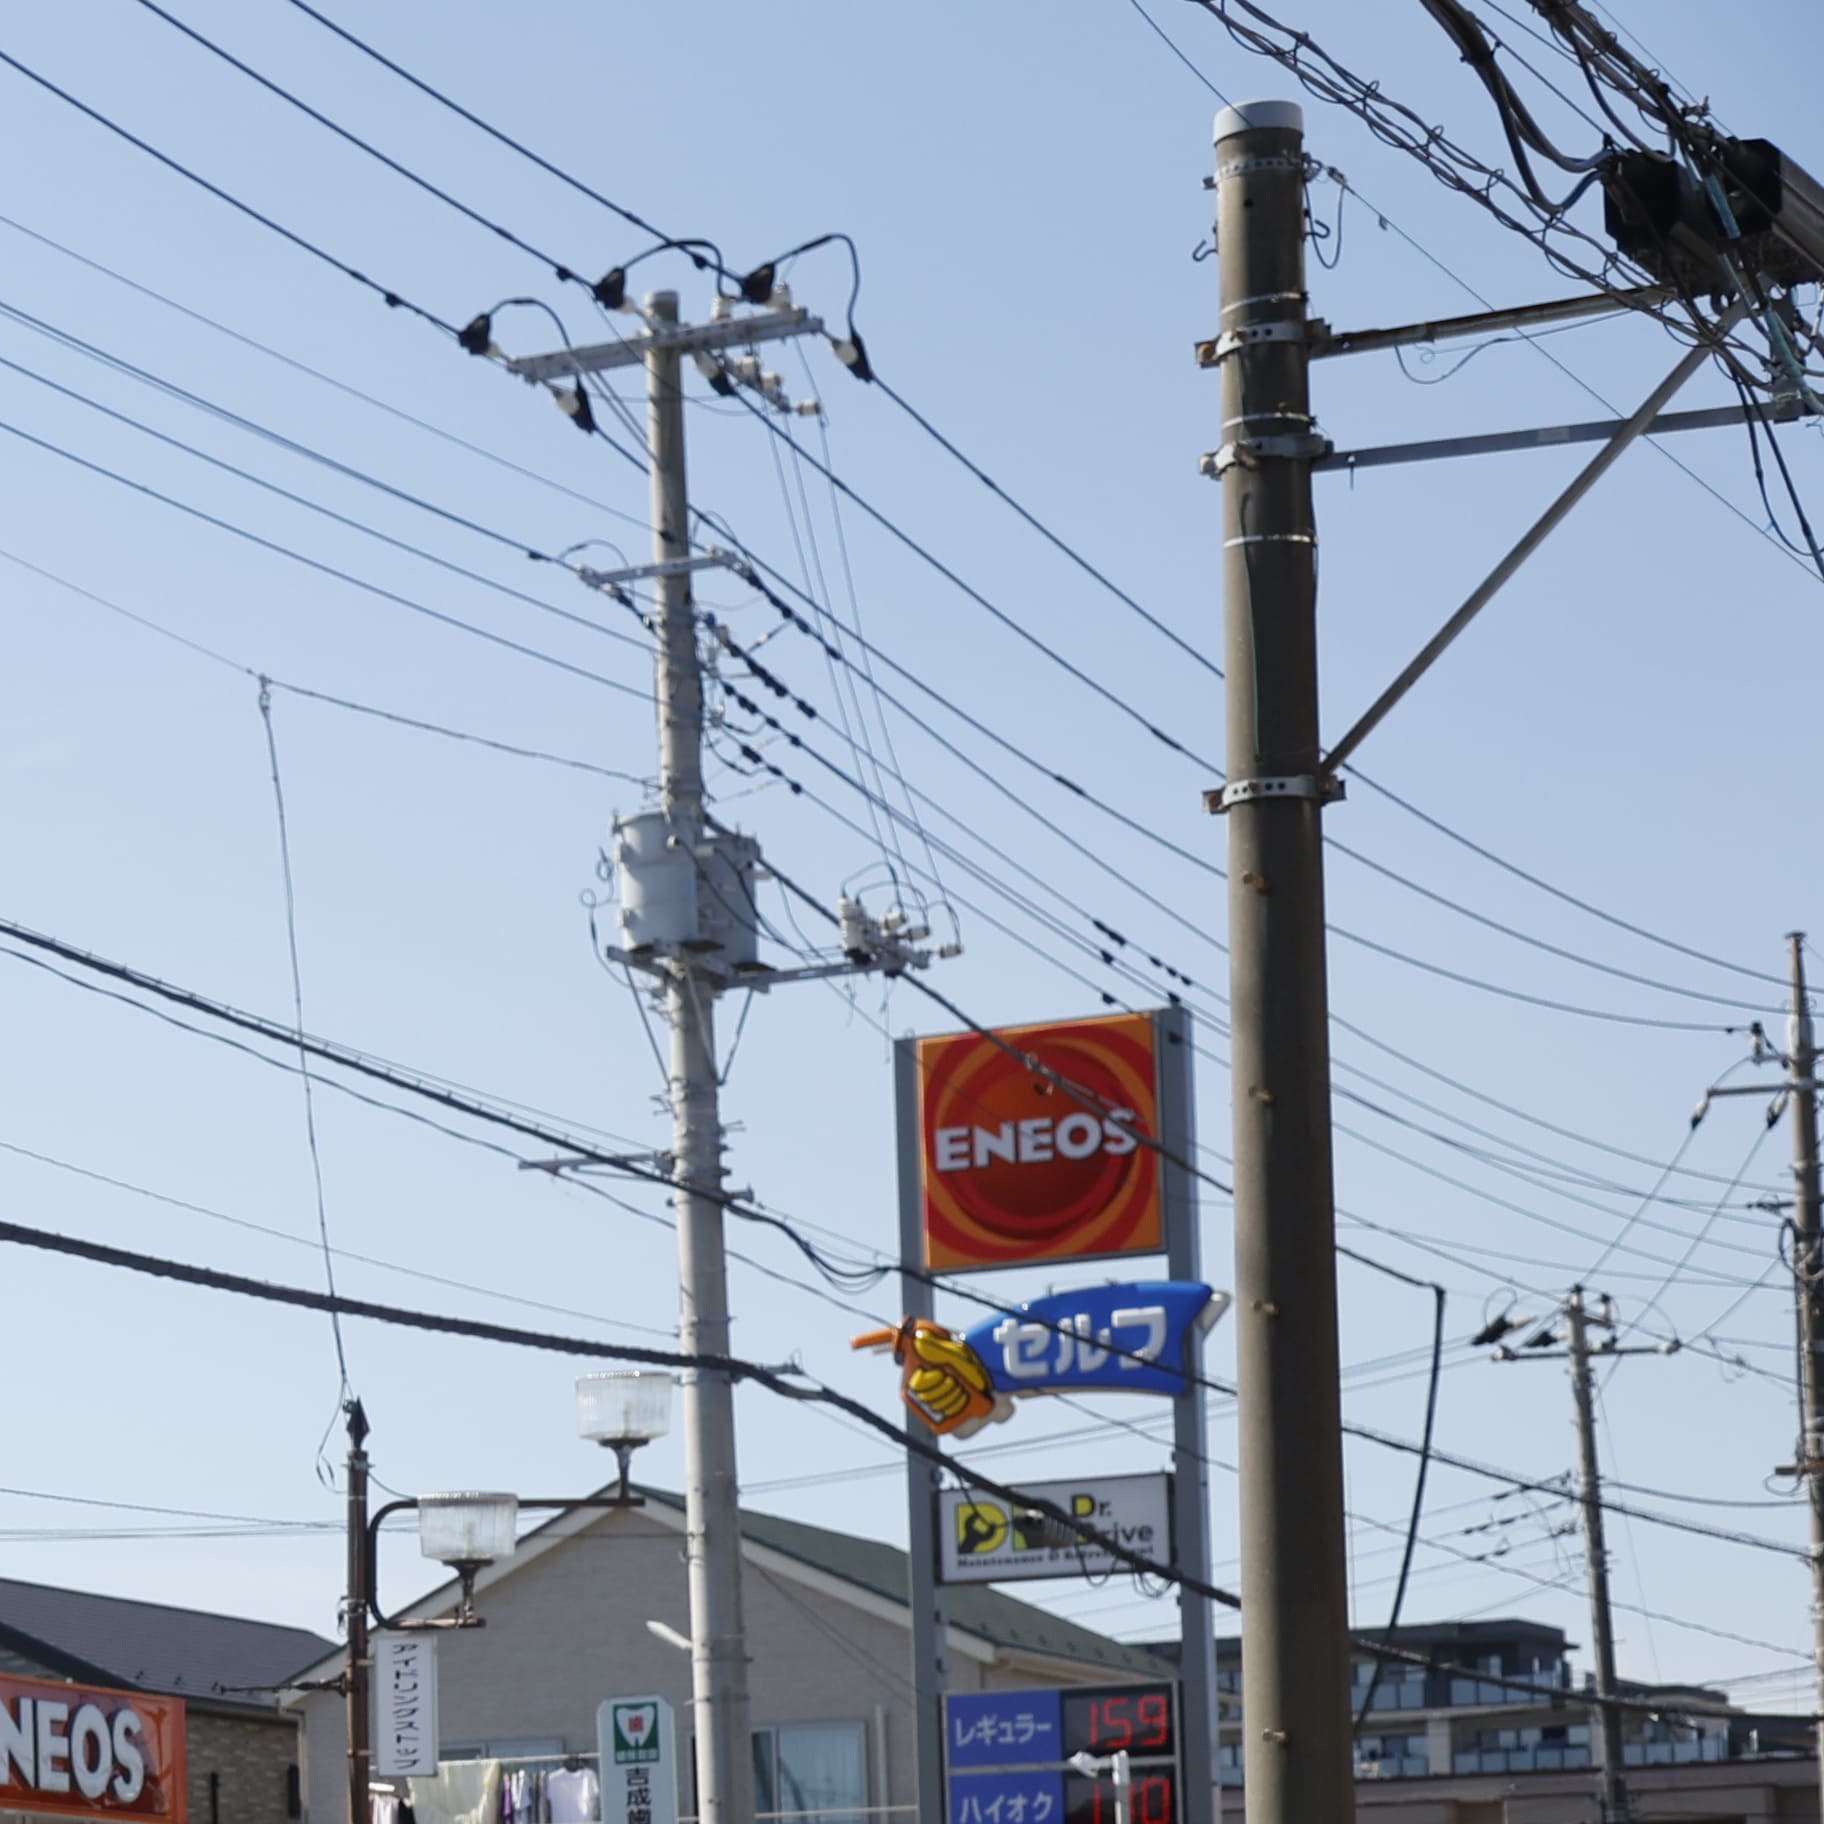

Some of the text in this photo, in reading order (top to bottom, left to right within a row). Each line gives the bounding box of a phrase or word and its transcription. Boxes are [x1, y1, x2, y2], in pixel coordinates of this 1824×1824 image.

[934, 1105, 1138, 1171] ENEOS
[992, 1305, 1167, 1376] セルフ
[955, 1695, 1170, 1748] レギュラー 159
[959, 1791, 1053, 1824] ハイオク
